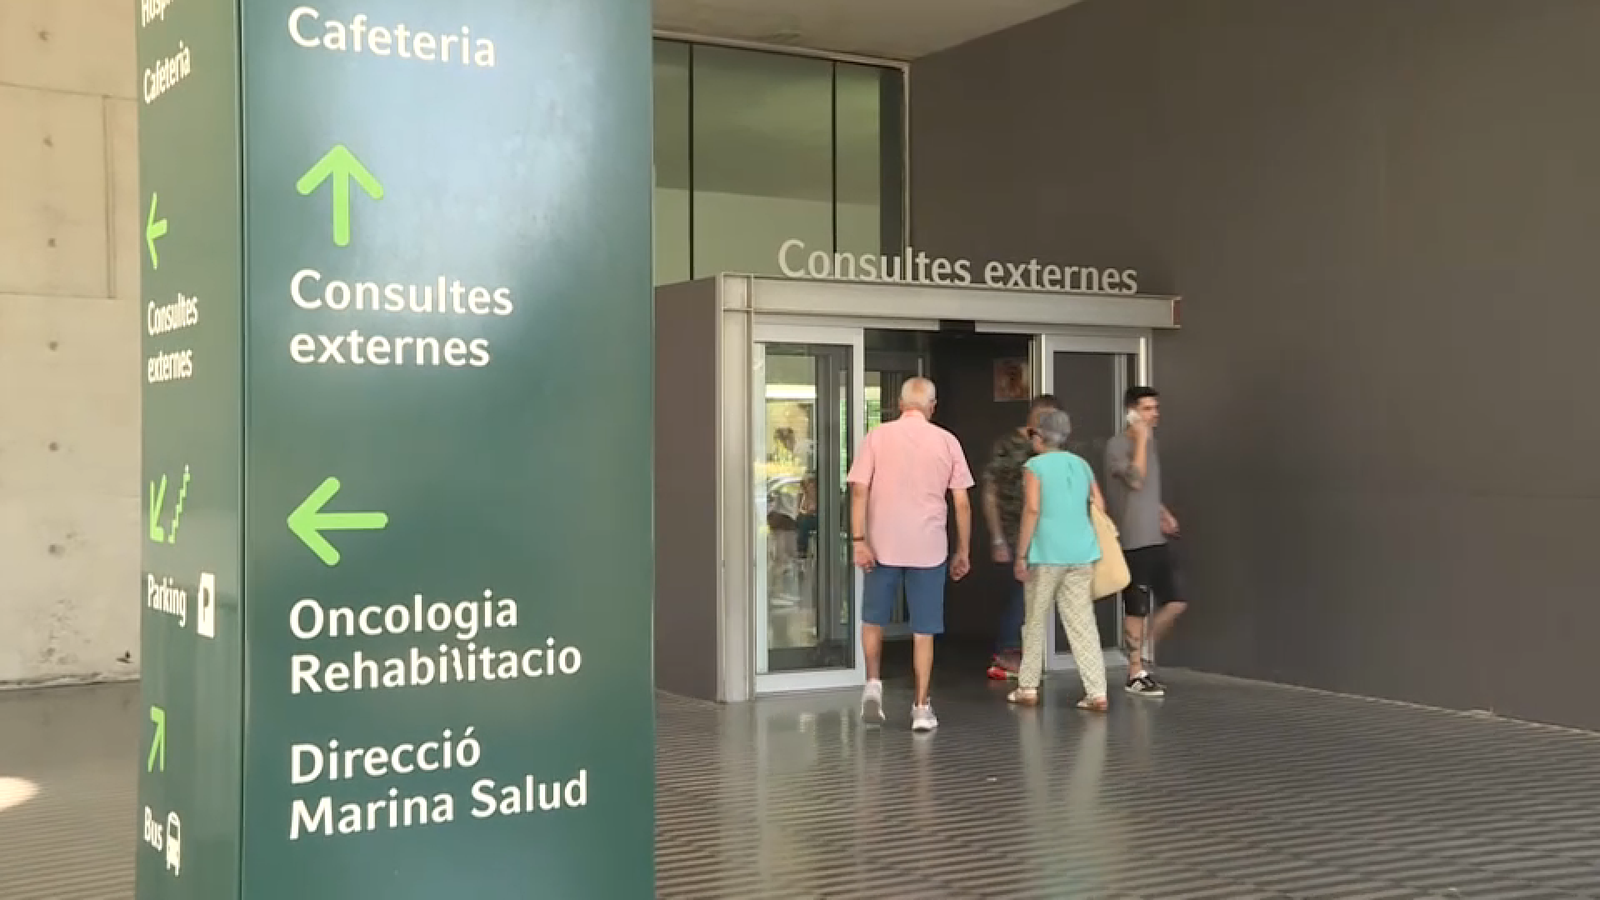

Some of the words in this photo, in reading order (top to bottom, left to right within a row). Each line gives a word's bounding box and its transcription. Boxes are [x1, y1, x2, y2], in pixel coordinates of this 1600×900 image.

[288, 6, 497, 69] Cafeteria
[143, 40, 191, 104] Cafeteria
[290, 269, 514, 317] Consultes
[777, 238, 972, 286] Consultes
[983, 259, 1139, 295] externes
[147, 292, 199, 336] Consultes
[147, 348, 193, 384] externes
[289, 328, 491, 368] externes
[147, 573, 187, 628] Parking
[289, 589, 519, 640] Oncologia
[290, 636, 582, 695] Rehabilitacio
[290, 726, 482, 785] Direcció
[143, 805, 164, 852] Bus
[289, 788, 455, 841] Marina
[470, 769, 589, 819] Salud
